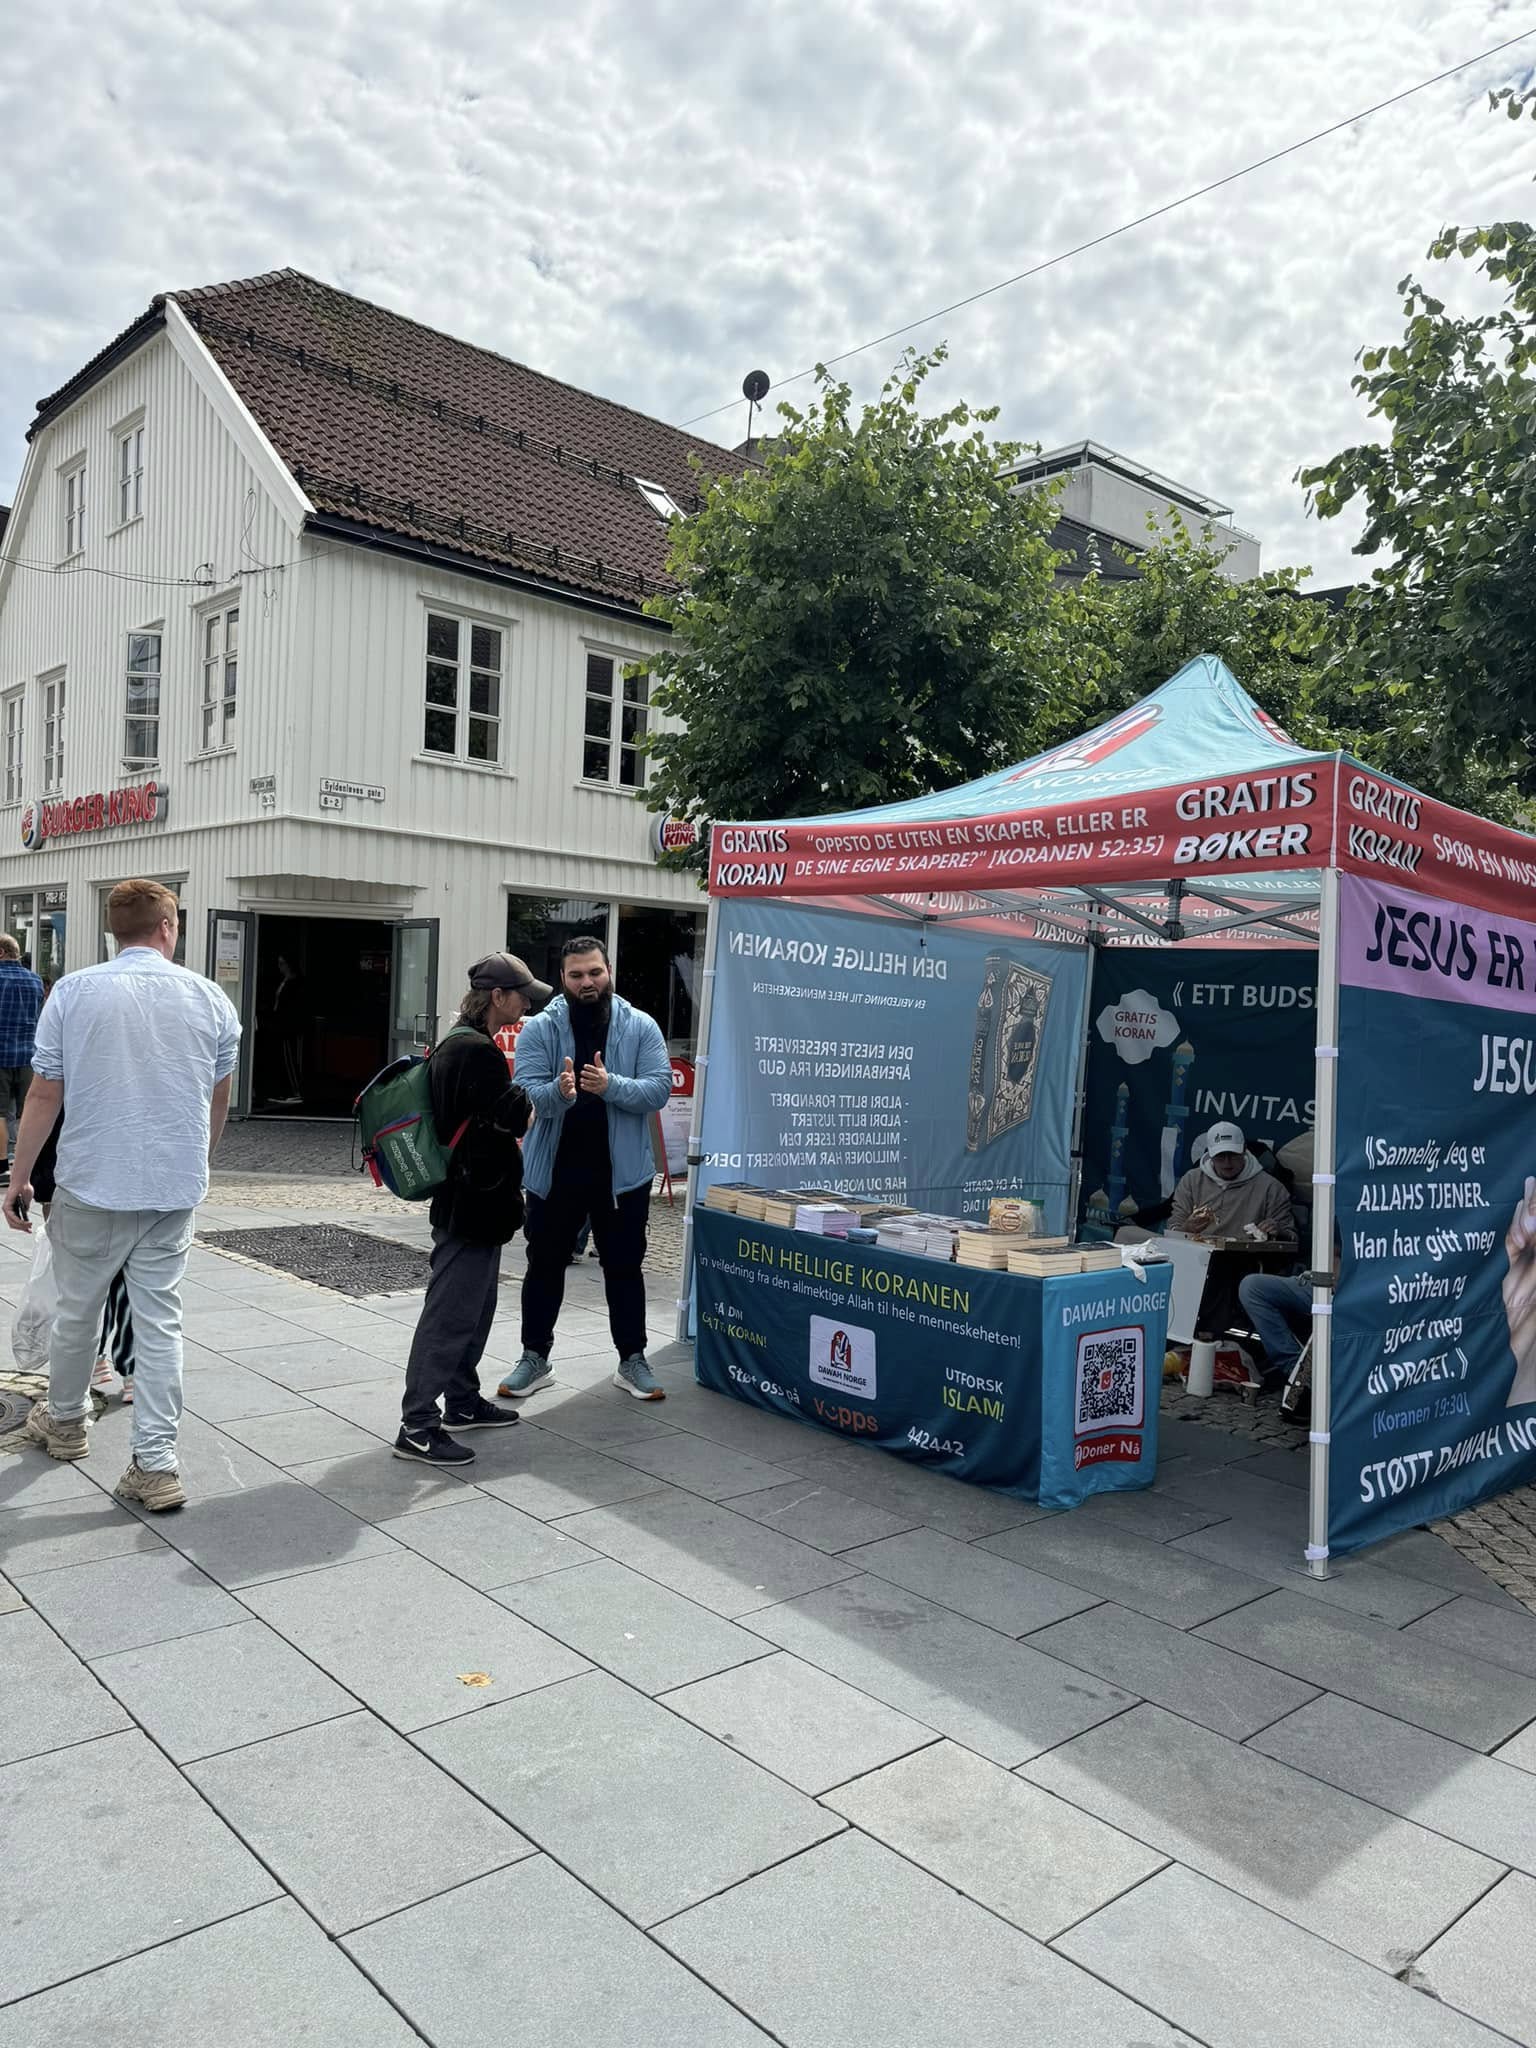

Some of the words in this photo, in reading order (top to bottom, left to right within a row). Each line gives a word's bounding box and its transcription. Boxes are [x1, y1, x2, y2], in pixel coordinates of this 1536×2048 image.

[41, 793, 105, 839] BURGER
[108, 781, 158, 827] KING
[1175, 772, 1315, 822] GRATIS
[1348, 775, 1422, 830] GRATIS
[721, 829, 790, 853] GRATIS
[875, 831, 895, 851] DE
[897, 828, 943, 850] UTEN
[946, 826, 971, 845] EN
[974, 819, 1051, 844] SKAPER,
[1056, 810, 1115, 836] ELLER
[1121, 807, 1149, 829] ER
[1172, 823, 1311, 865] BØKER
[795, 861, 812, 876] DE
[815, 859, 851, 876] SINE
[852, 855, 894, 874] EGNE
[988, 841, 1093, 870] [KORANEN
[1097, 834, 1165, 858] 52:35]
[1347, 824, 1422, 874] KORAN
[1432, 832, 1479, 872] SPØR
[1478, 848, 1503, 878] EN
[716, 862, 787, 887] KORAN
[1366, 902, 1478, 982] JESUS
[1487, 930, 1525, 992] ER
[1192, 983, 1235, 1006] ETT
[1242, 985, 1318, 1009] BUDS
[1114, 1010, 1158, 1025] GRATIS
[1114, 1025, 1157, 1041] KORAN
[1443, 1140, 1468, 1173] Jeg
[1470, 1145, 1486, 1166] er
[1356, 1182, 1424, 1213] ALLAHS
[1427, 1182, 1490, 1210] TJENER.
[1352, 1231, 1388, 1261] Han
[1392, 1228, 1420, 1258] har
[1426, 1227, 1463, 1262] gitt
[1465, 1229, 1496, 1256] meg
[738, 1238, 774, 1267] DEN
[780, 1248, 855, 1287] HELLIGE
[861, 1266, 970, 1314] KORANEN
[1388, 1271, 1448, 1305] skriften
[711, 1255, 755, 1284] veiledning
[757, 1269, 770, 1286] fra
[772, 1274, 791, 1292] den
[792, 1279, 845, 1307] allmektige
[847, 1293, 875, 1313] Allah
[877, 1299, 889, 1316] til
[891, 1304, 916, 1323] hele
[919, 1314, 1022, 1350] menneskeheten!
[1062, 1297, 1117, 1328] DAWAH
[1119, 1291, 1167, 1315] NORGE
[728, 1323, 768, 1349] KORAN!
[1383, 1320, 1423, 1354] gjort
[1428, 1315, 1463, 1341] meg
[818, 1365, 843, 1379] DAWAH
[843, 1371, 867, 1386] NORGE
[945, 1367, 1004, 1395] UTFORSK
[1367, 1364, 1388, 1396] til
[1390, 1351, 1456, 1391] PROFET.
[942, 1386, 1005, 1423] ISLAM!
[1371, 1405, 1431, 1439] [Koranen
[907, 1426, 965, 1457] 442442
[1081, 1444, 1115, 1461] Doner
[1119, 1440, 1141, 1455] Nå
[1359, 1449, 1434, 1503] STØTT
[1434, 1425, 1503, 1478] DAWAH
